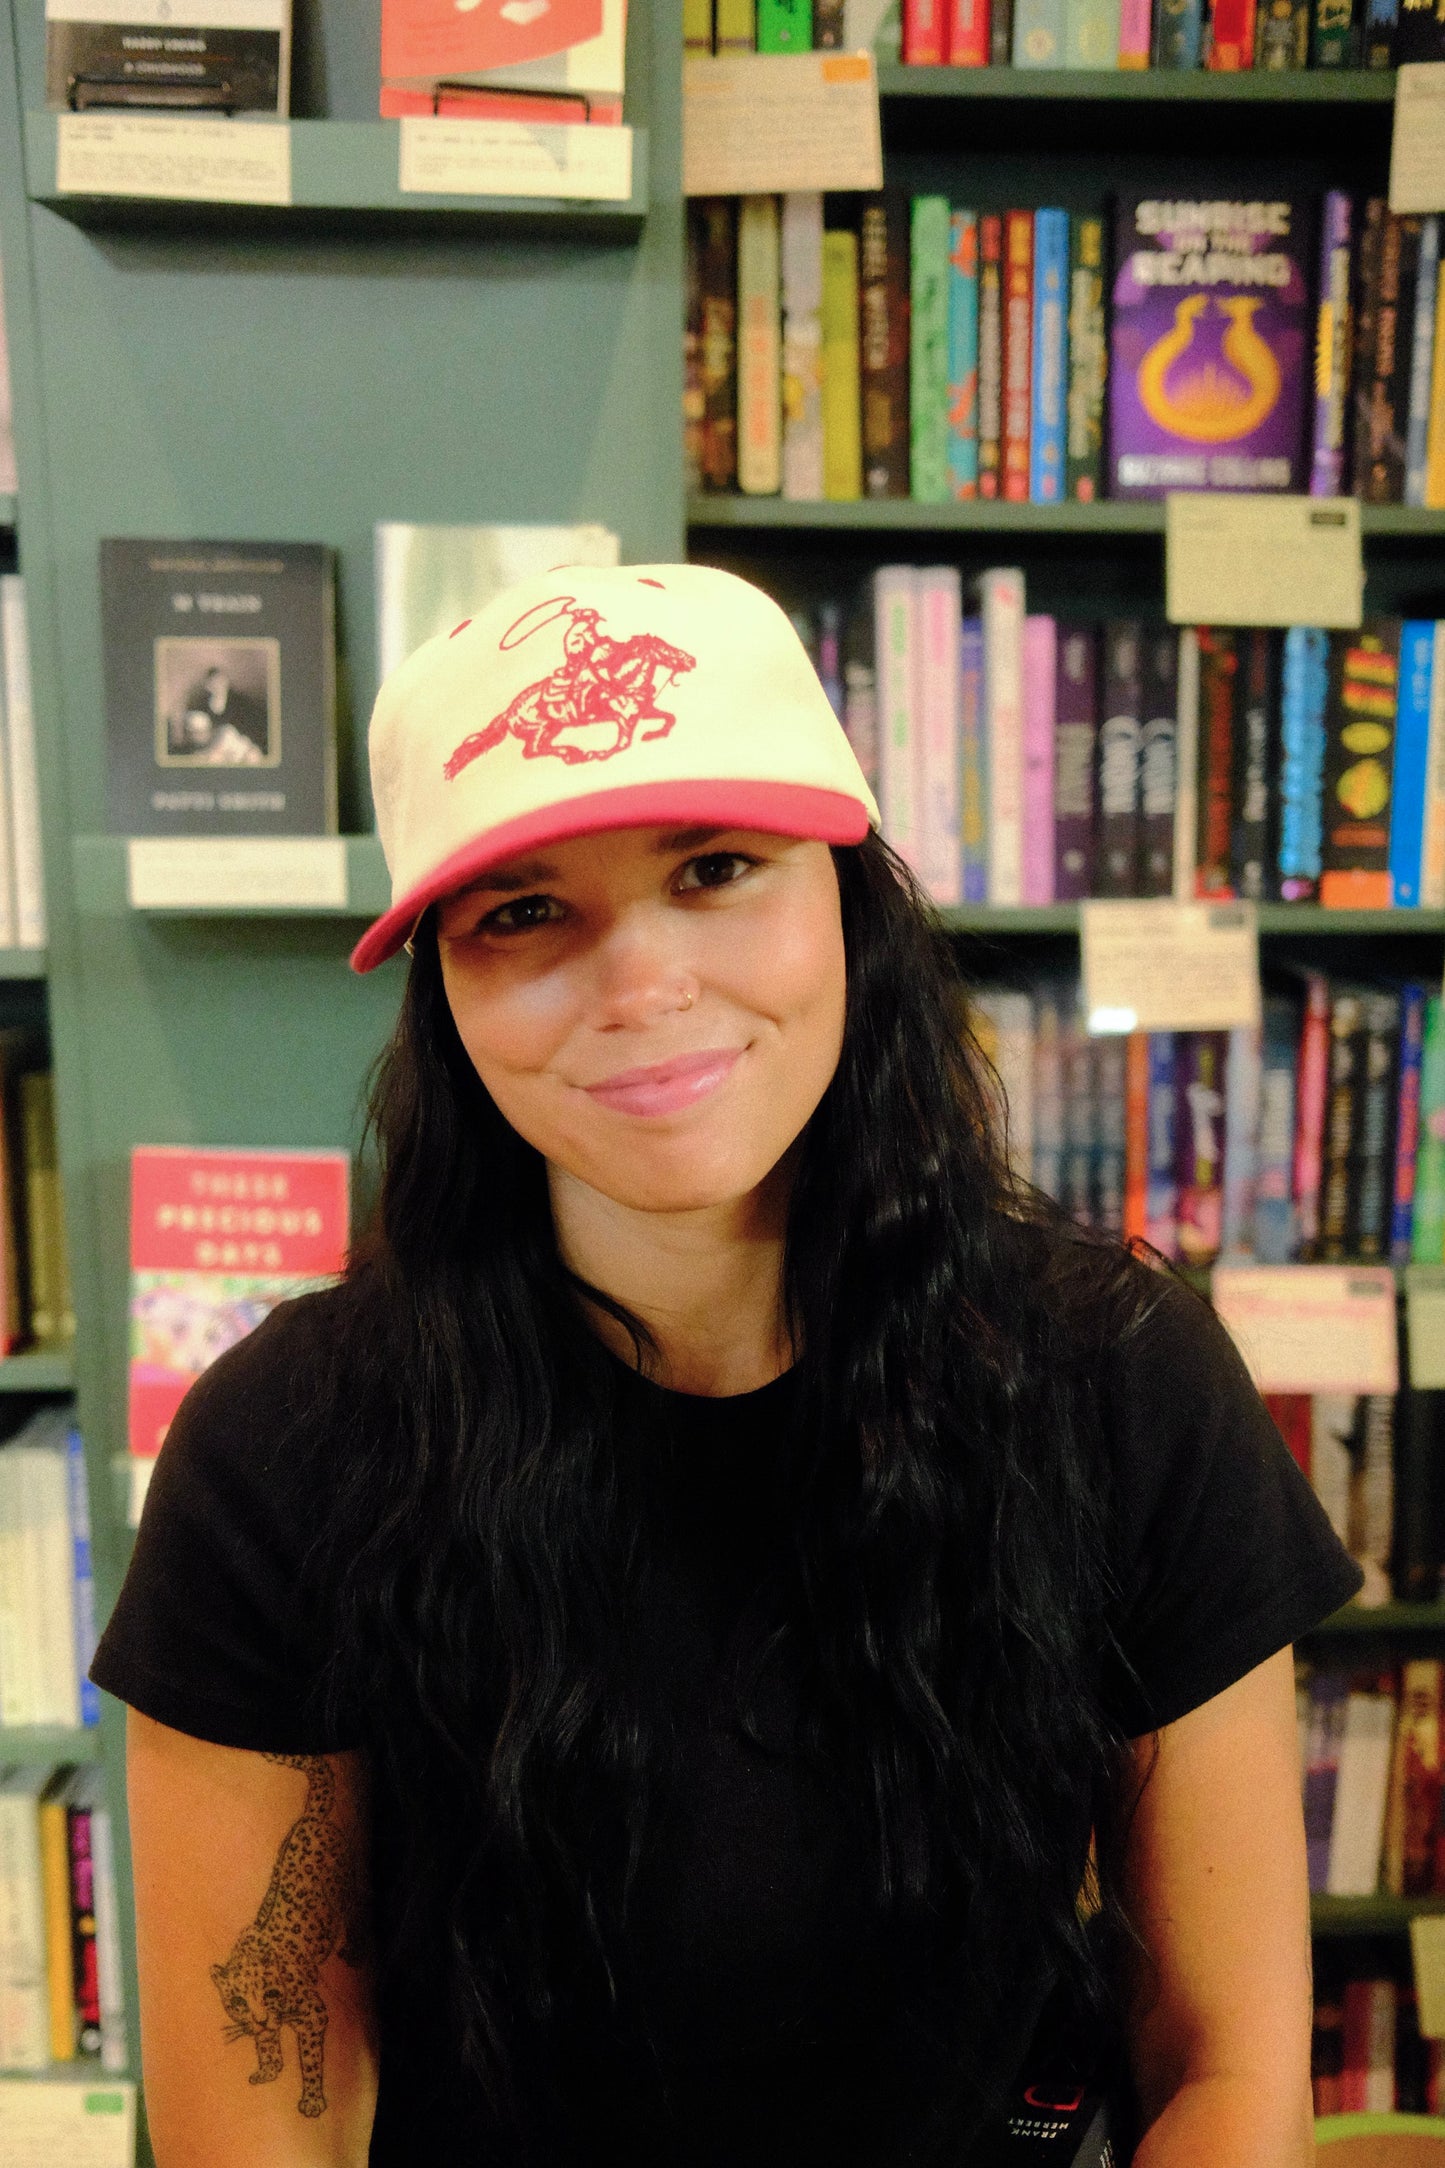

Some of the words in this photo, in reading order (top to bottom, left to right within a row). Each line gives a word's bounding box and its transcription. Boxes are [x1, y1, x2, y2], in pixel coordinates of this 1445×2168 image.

[1134, 201, 1292, 235] SUNRISE
[157, 1203, 323, 1237] PRECIOUS
[1008, 2118, 1070, 2130] HERBERT
[1011, 2128, 1057, 2139] FRANK
